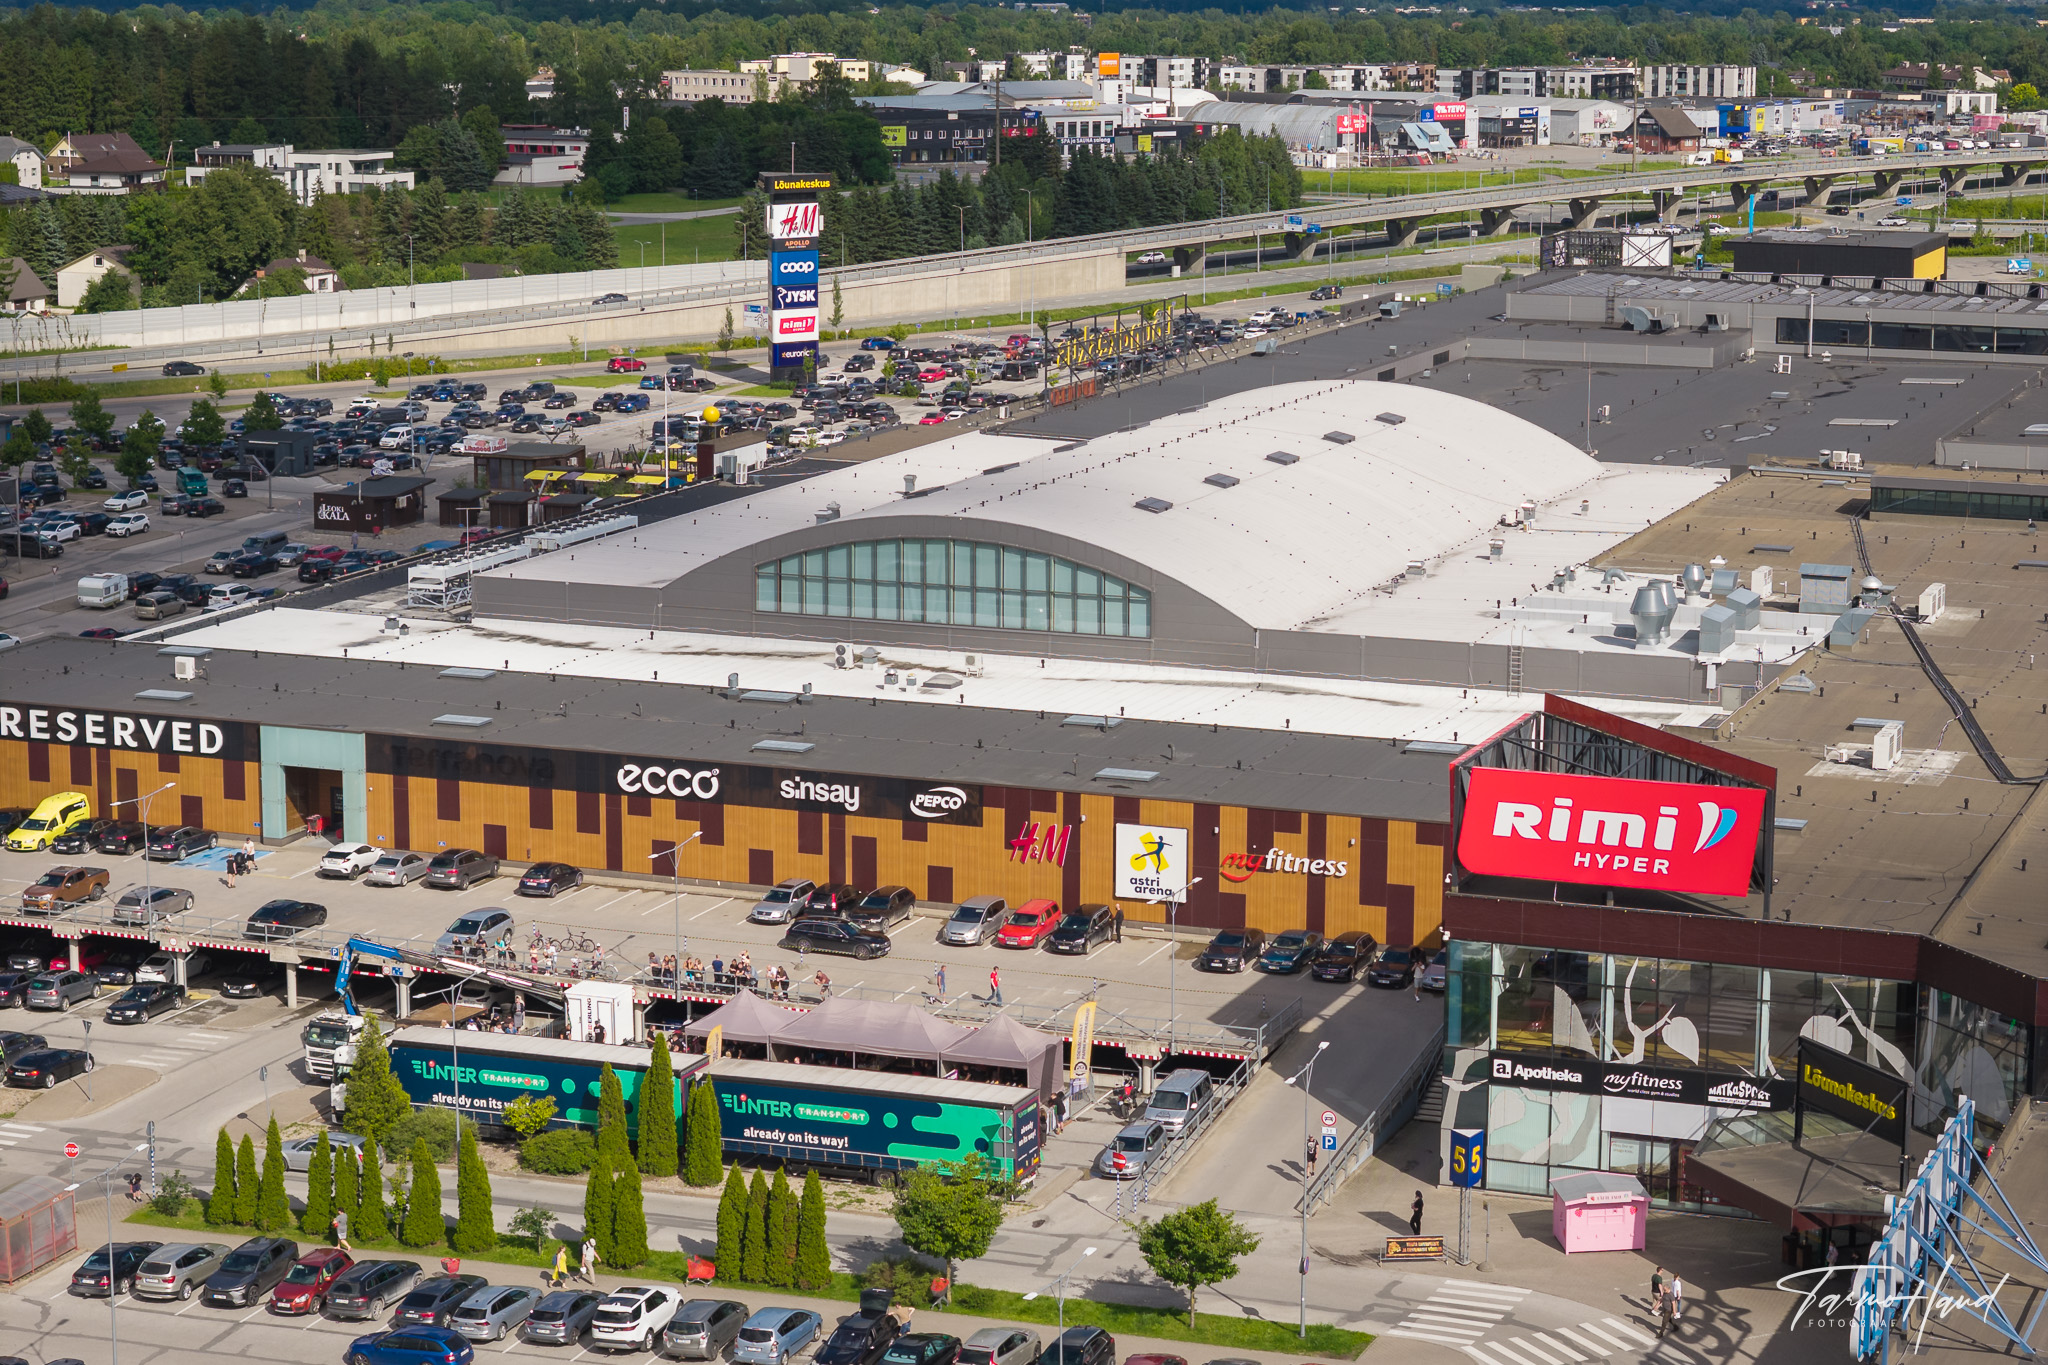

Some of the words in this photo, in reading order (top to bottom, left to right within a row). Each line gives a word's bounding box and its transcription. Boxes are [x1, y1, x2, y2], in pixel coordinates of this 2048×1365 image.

[774, 179, 830, 189] Lõunakeskus
[780, 205, 818, 236] H&M
[780, 261, 815, 273] coop
[785, 290, 816, 303] JYSK
[785, 350, 811, 358] euronic
[323, 511, 350, 521] KALA
[0, 706, 223, 754] RESERVED
[617, 764, 720, 799] ecco
[780, 776, 860, 812] sinsay
[915, 794, 962, 810] PEPCO
[1009, 821, 1072, 868] H&M
[1573, 852, 1670, 875] HYPER
[1130, 876, 1160, 887] astri
[1134, 885, 1173, 896] arena
[1514, 1064, 1582, 1083] Apotheka
[432, 1092, 471, 1108] already
[473, 1099, 487, 1108] on
[489, 1097, 503, 1110] its
[1804, 1064, 1896, 1120] Lõunakeskus
[743, 1126, 786, 1143] already
[788, 1133, 803, 1142] on
[804, 1132, 819, 1144] its
[820, 1136, 849, 1149] way!
[1325, 1136, 1334, 1149] P
[1453, 1145, 1466, 1173] 5
[1470, 1145, 1481, 1174] 5
